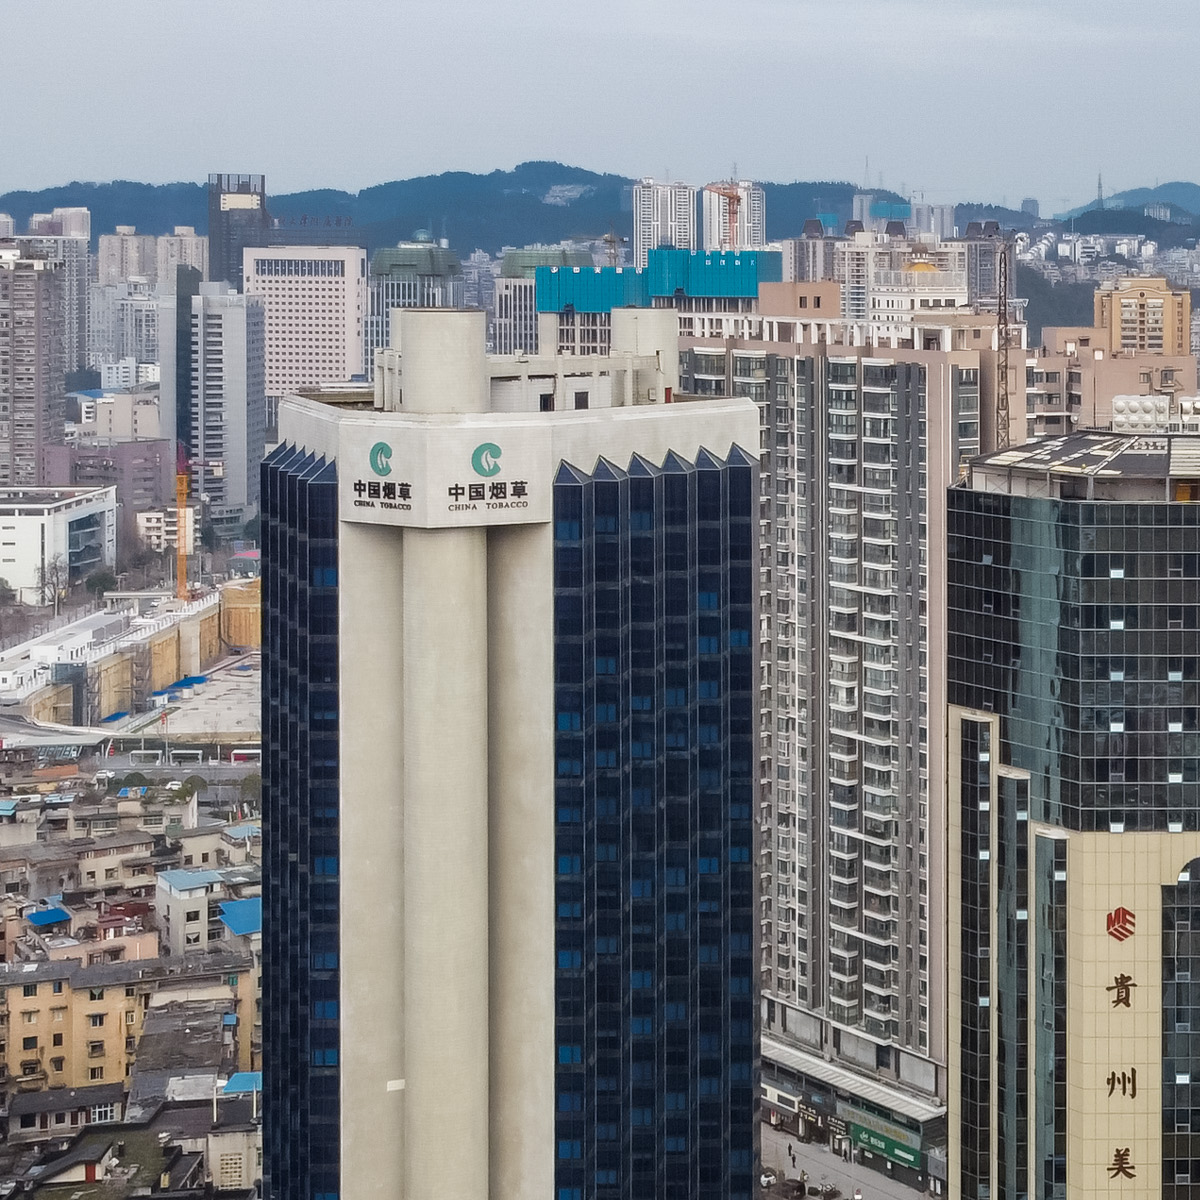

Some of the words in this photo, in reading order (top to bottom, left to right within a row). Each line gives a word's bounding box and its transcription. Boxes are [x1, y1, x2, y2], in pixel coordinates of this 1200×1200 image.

[353, 479, 412, 501] 中国烟草
[448, 480, 528, 501] 中国烟草
[354, 500, 375, 508] CHINA
[380, 501, 412, 511] TOBACCO
[448, 503, 478, 511] CHINA
[486, 501, 528, 510] TOBACCO
